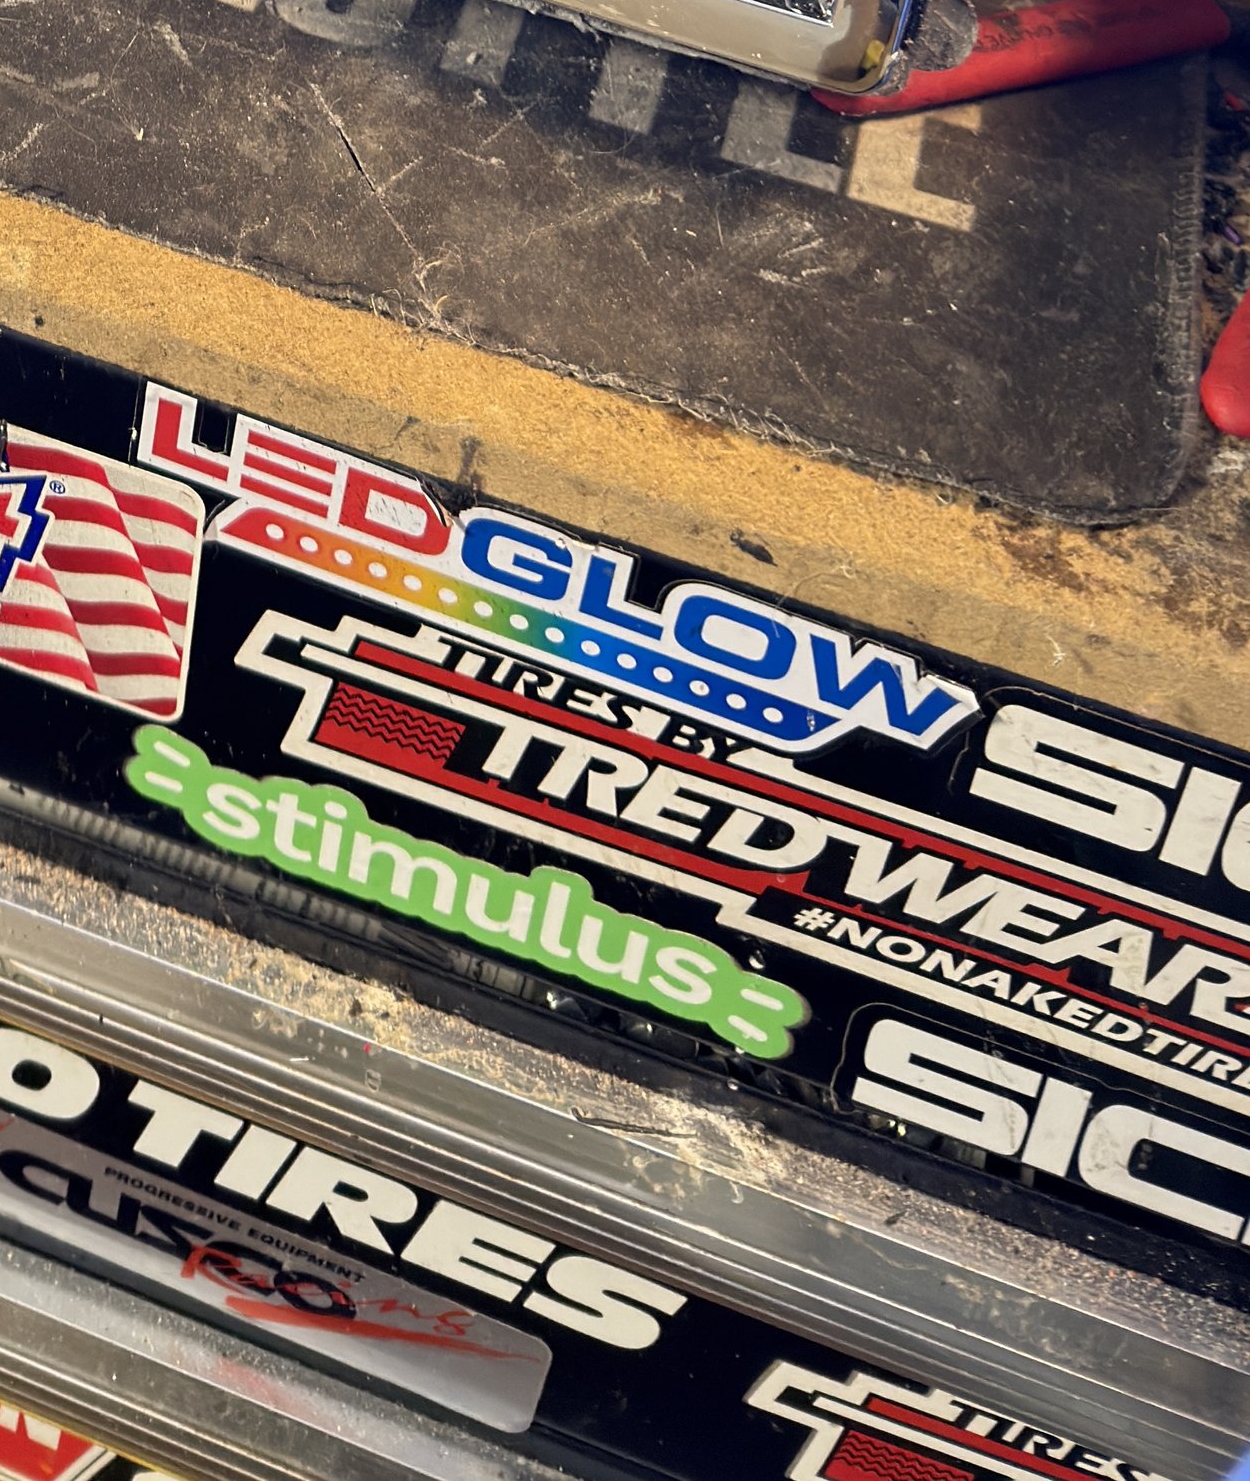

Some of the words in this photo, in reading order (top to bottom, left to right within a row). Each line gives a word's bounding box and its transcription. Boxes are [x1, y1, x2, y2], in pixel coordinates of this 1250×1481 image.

[150, 395, 963, 735] LEDGLOW
[439, 635, 644, 731] TIRES
[667, 715, 744, 762] BY
[969, 704, 1250, 892] SI
[203, 781, 714, 1005] stimulus
[104, 1165, 241, 1231] PROGRESSIVE
[247, 1227, 367, 1284] EQUIPMENT
[128, 1079, 688, 1349] TIRES
[852, 1019, 1250, 1245] SIC
